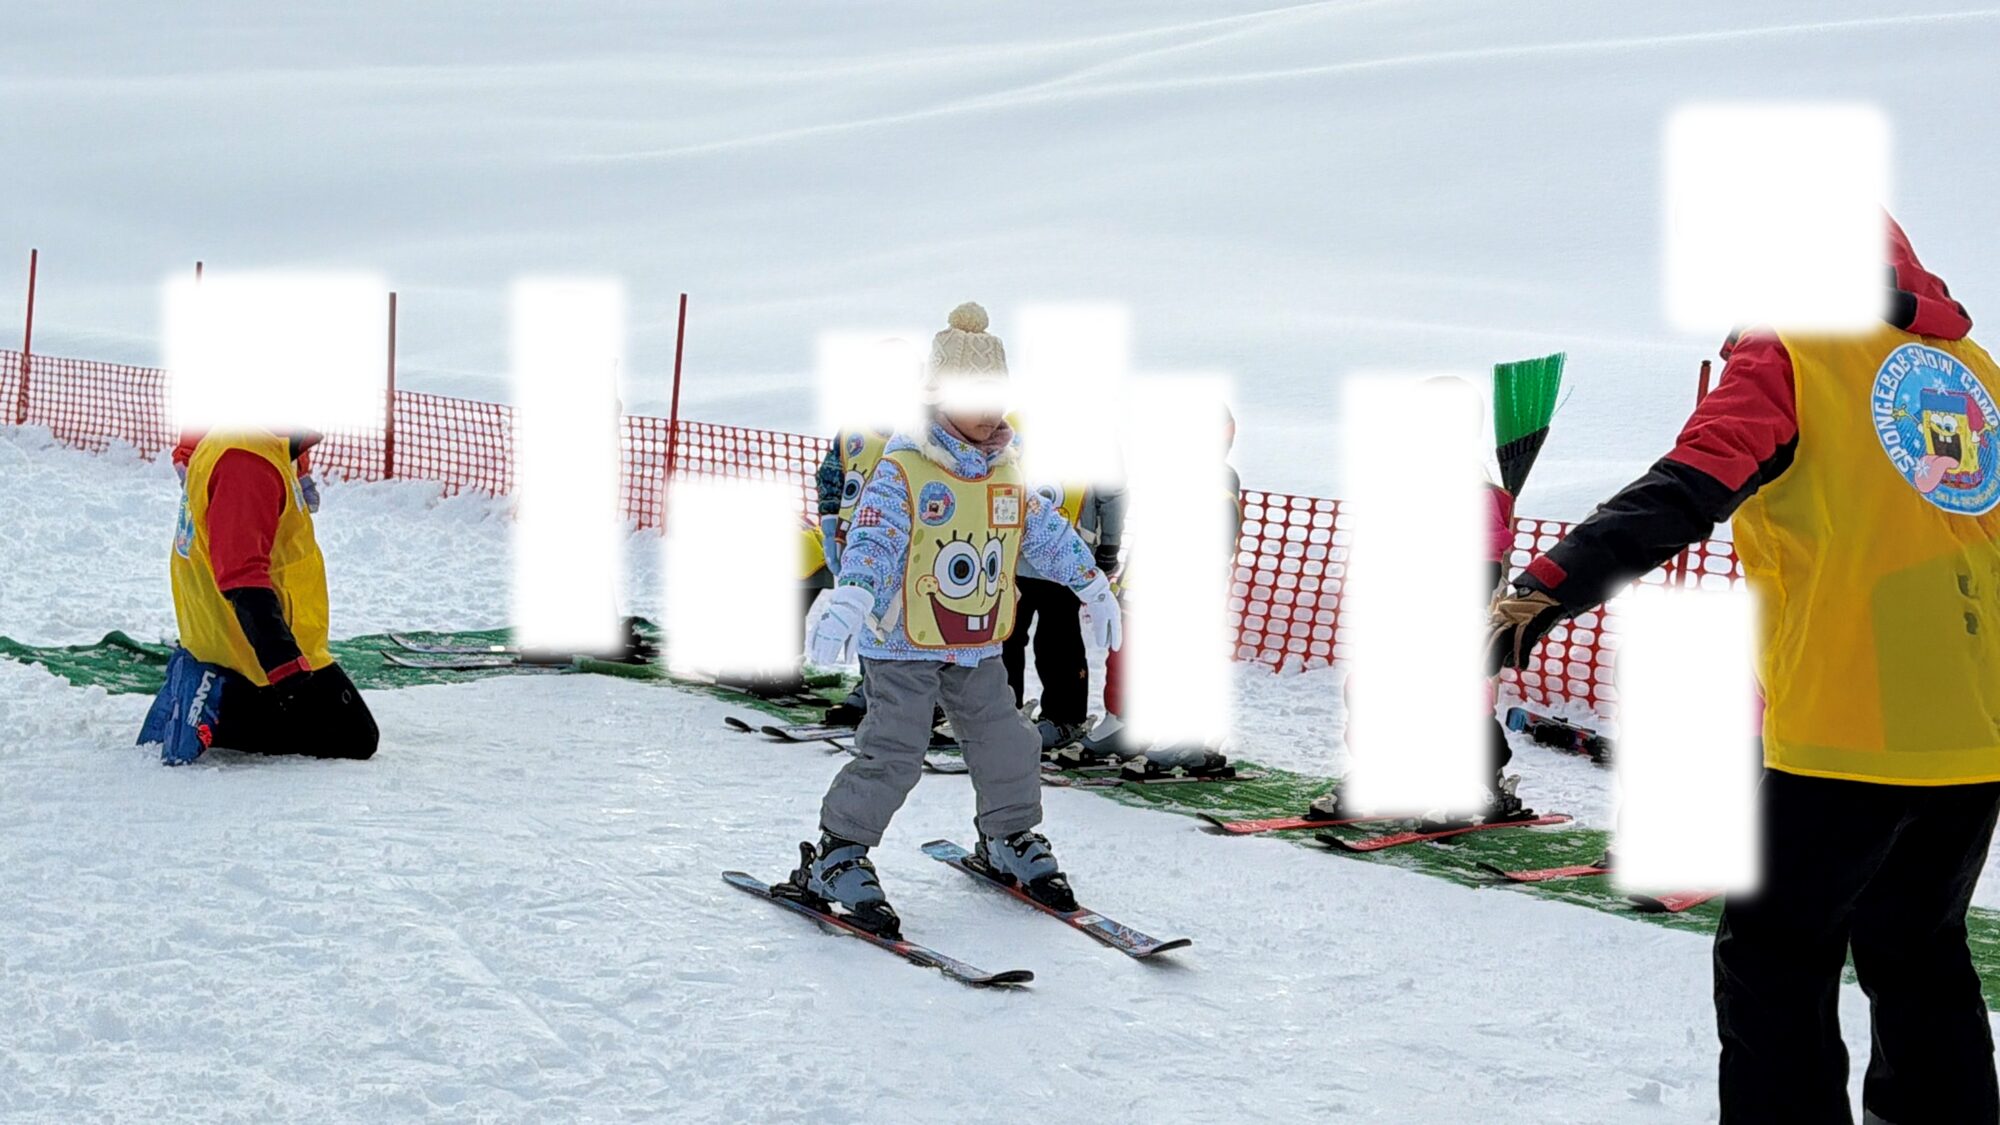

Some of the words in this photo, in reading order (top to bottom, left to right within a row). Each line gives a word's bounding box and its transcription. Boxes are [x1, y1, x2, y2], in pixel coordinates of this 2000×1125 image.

[1875, 352, 1916, 473] SPONGEBOB
[1909, 348, 1953, 375] SNOW
[1960, 373, 1999, 428] CAMP
[188, 671, 216, 727] LANGE
